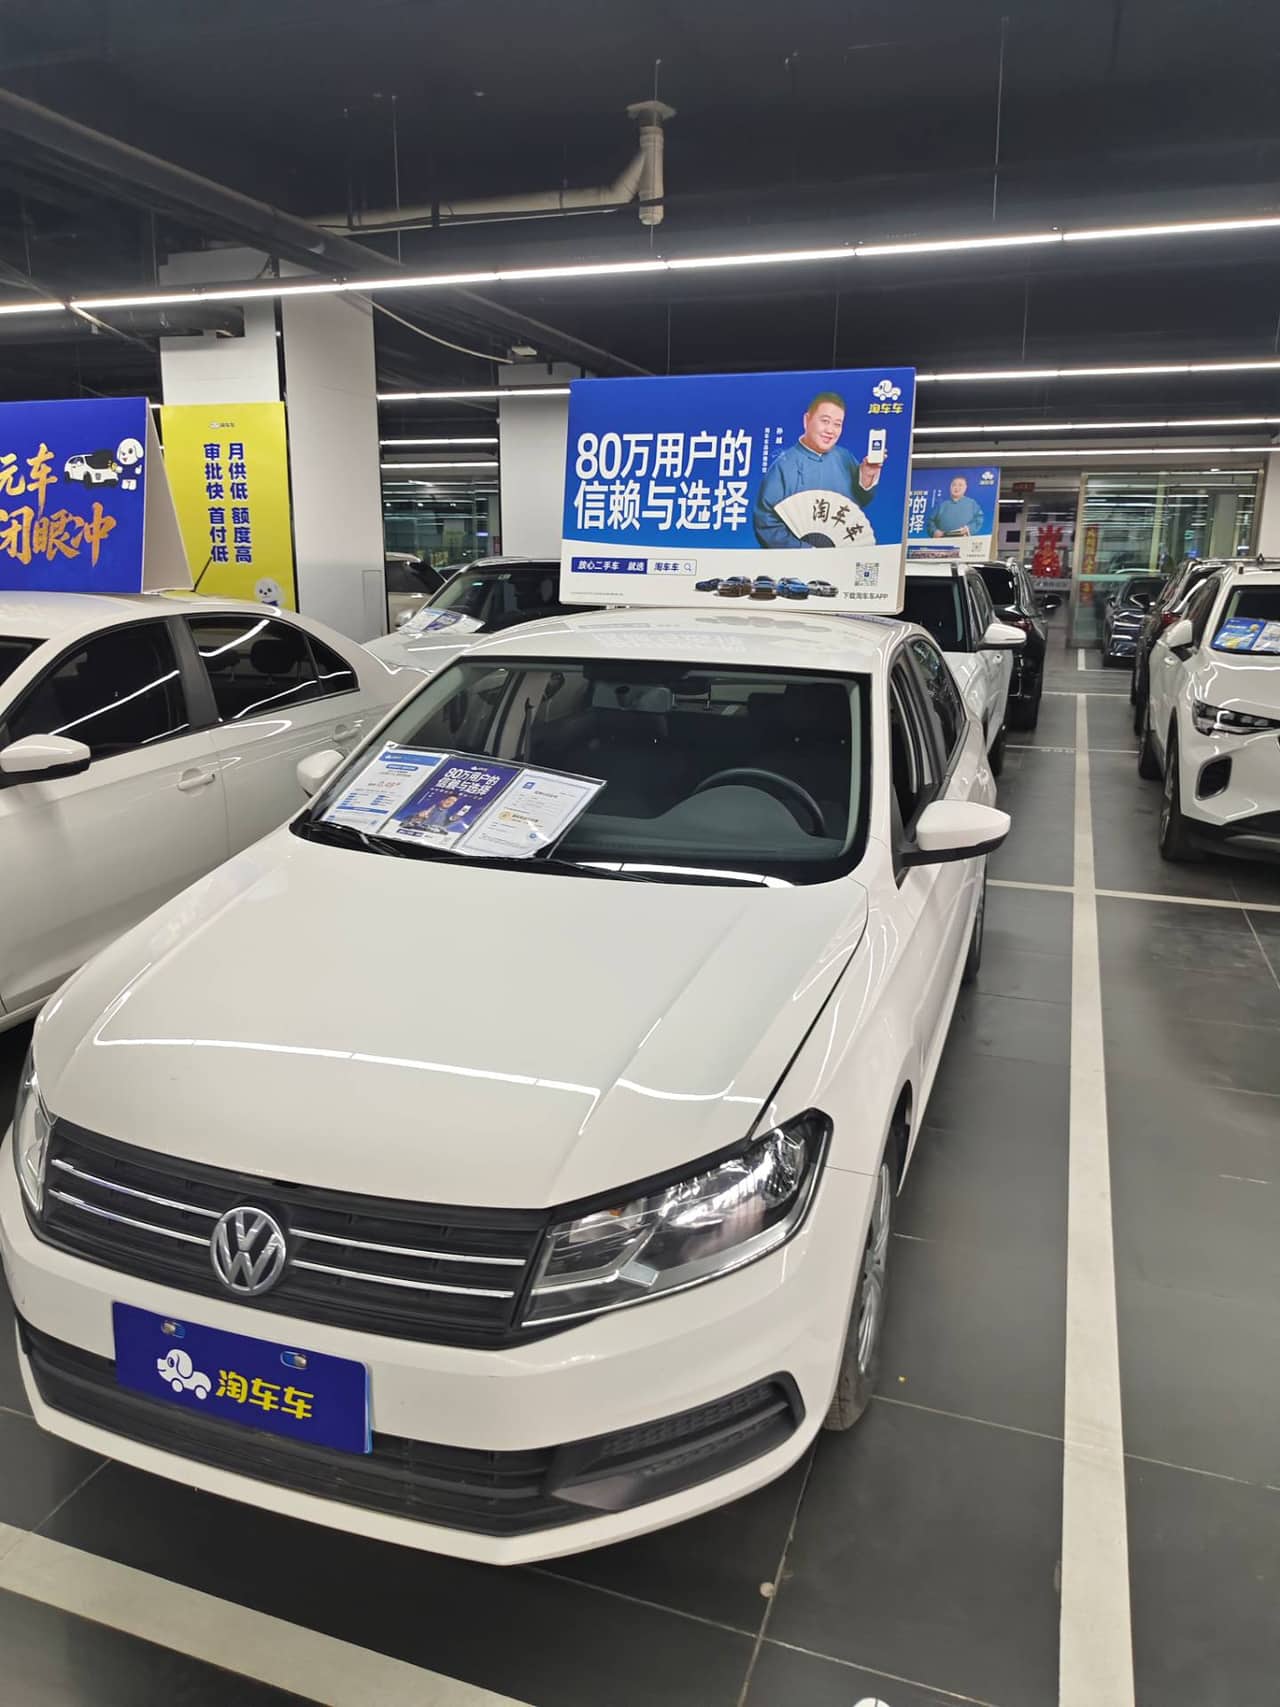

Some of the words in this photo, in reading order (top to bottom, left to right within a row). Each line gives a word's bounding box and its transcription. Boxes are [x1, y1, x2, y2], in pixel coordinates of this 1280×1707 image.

[867, 403, 905, 414] 淘车车
[203, 443, 224, 500] 审批快
[228, 443, 248, 500] 月供低
[575, 429, 752, 479] 80万用户的
[574, 479, 749, 531] 信赖与选择
[812, 498, 865, 542] 淘车车
[0, 501, 117, 568] 闭眼冲
[208, 507, 229, 563] 首付低
[231, 507, 252, 563] 额度高
[577, 560, 620, 571] 放心二手车
[654, 562, 681, 572] 淘车车
[216, 1369, 315, 1420] 淘车车
